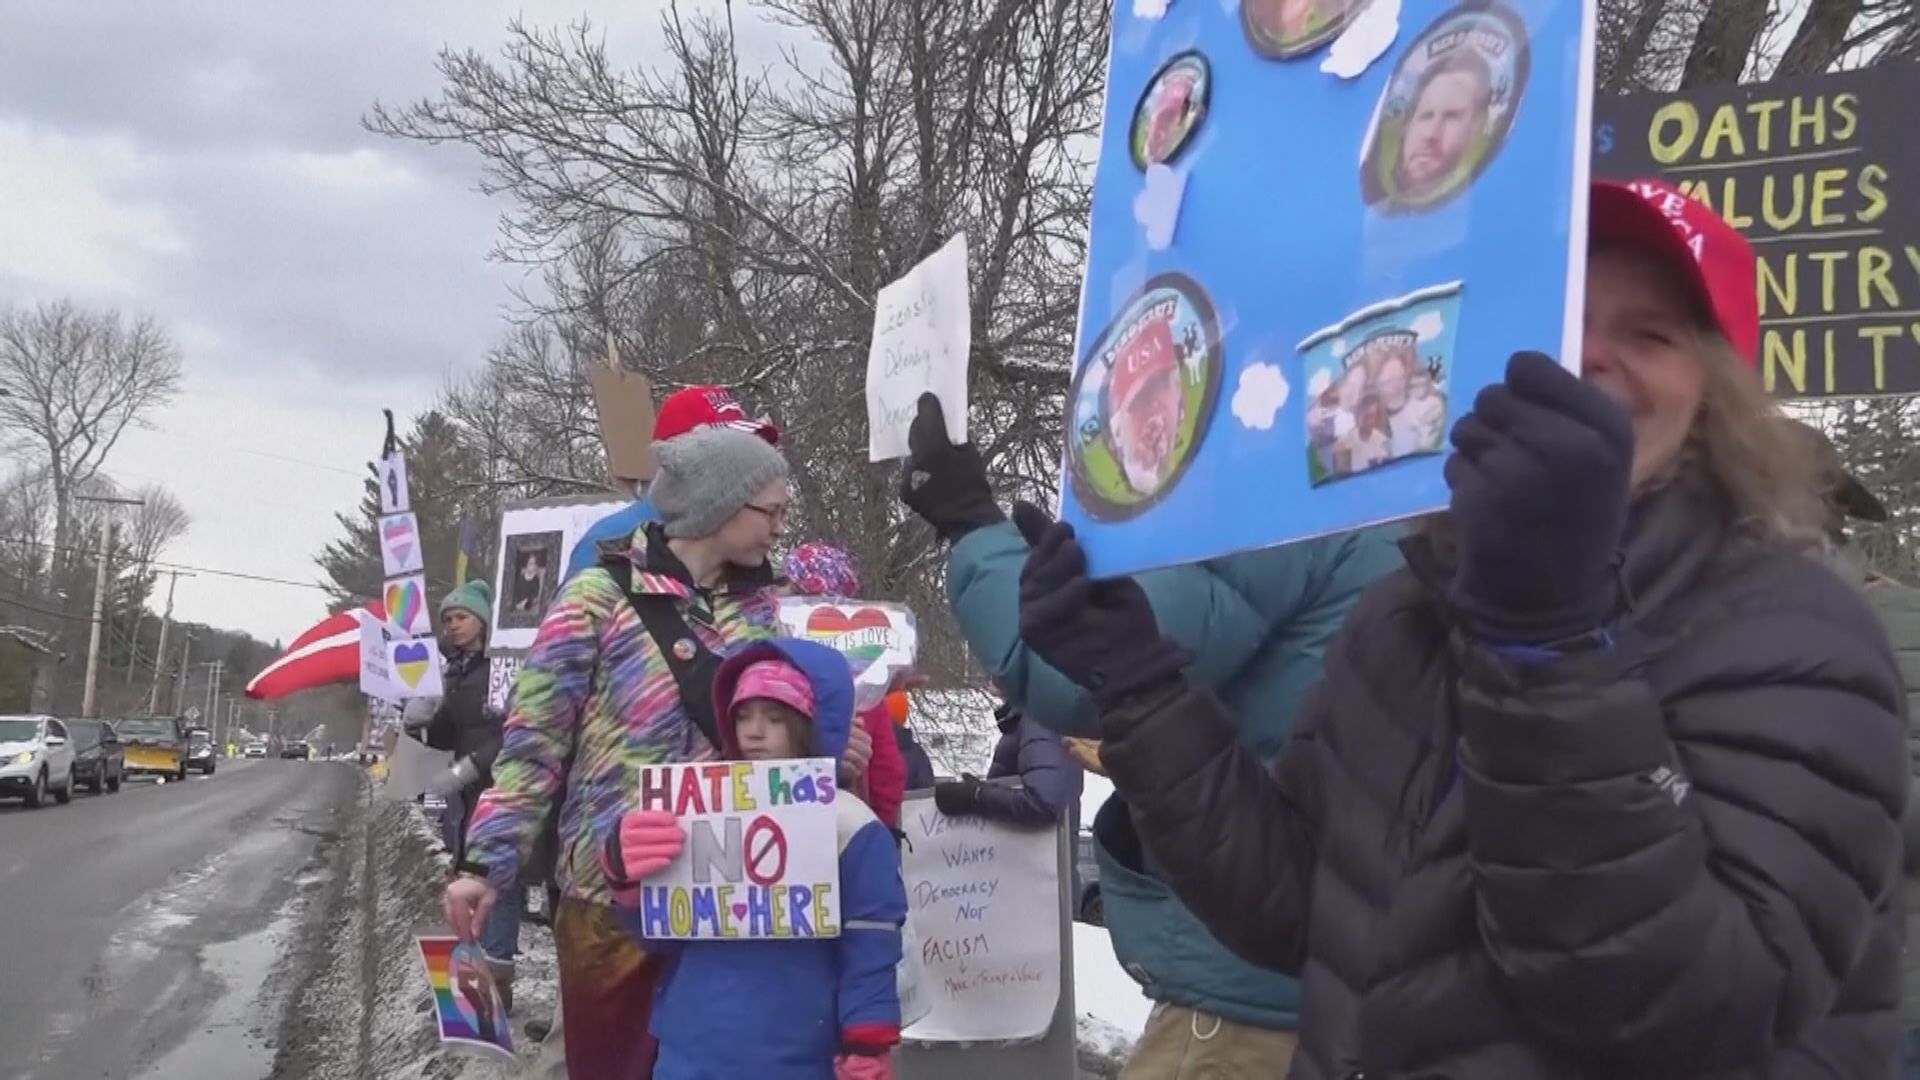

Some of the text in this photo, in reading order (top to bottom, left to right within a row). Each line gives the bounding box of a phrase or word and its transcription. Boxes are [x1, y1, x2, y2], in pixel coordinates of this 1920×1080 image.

[1648, 93, 1859, 164] OATHS
[1678, 163, 1888, 231] ALUES
[844, 634, 856, 650] IS
[861, 627, 890, 646] LOVE
[642, 762, 836, 816] HATE has
[691, 814, 788, 886] NO
[942, 843, 995, 868] WANTS
[643, 882, 837, 937] HOME HERE
[913, 878, 1000, 910] DEMOCRACY
[922, 933, 989, 965] FACISM
